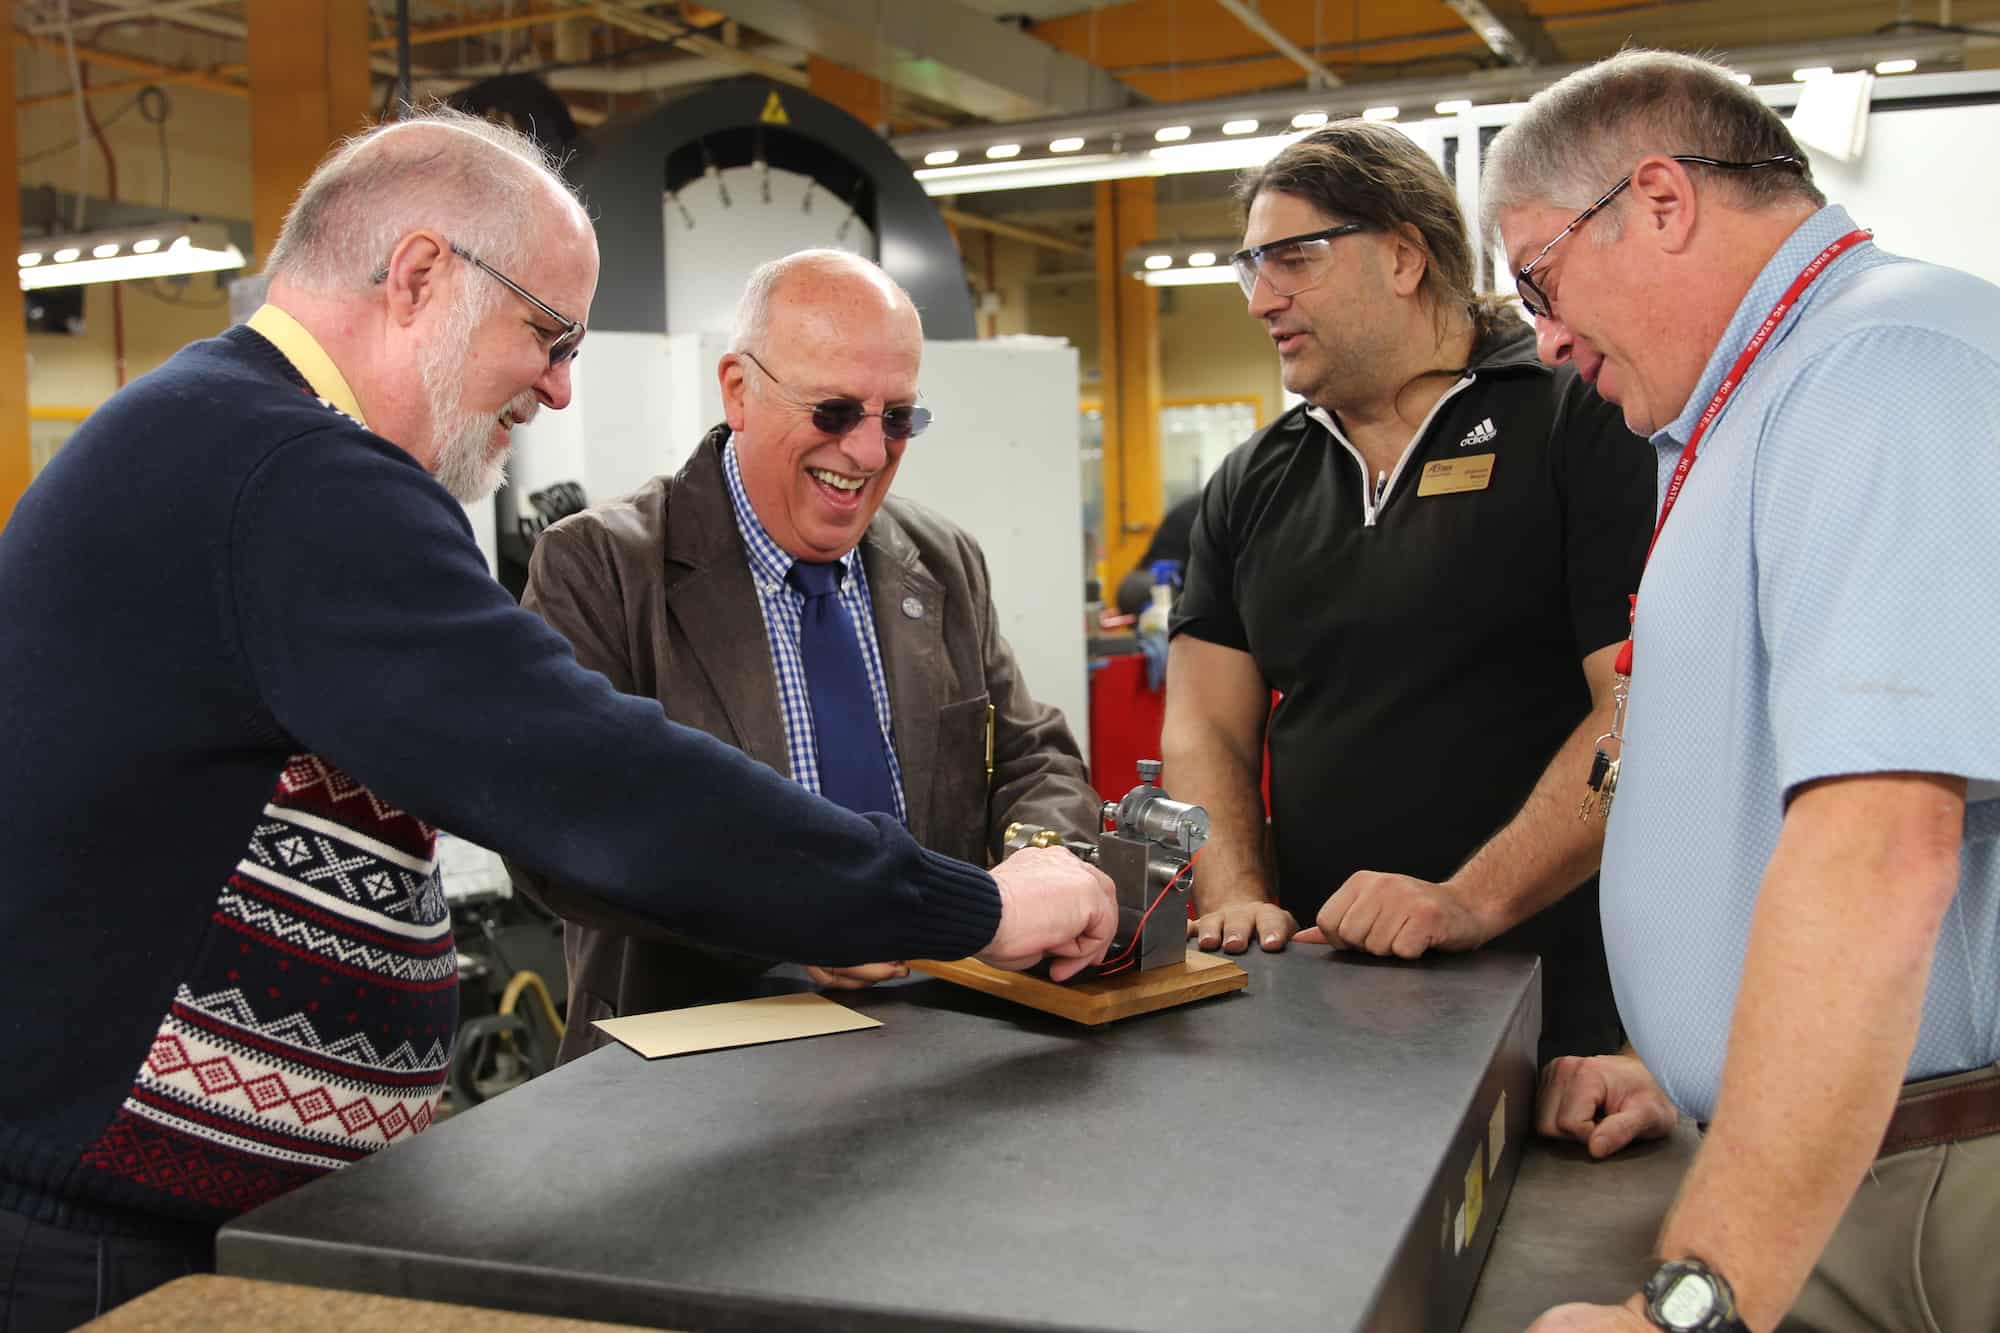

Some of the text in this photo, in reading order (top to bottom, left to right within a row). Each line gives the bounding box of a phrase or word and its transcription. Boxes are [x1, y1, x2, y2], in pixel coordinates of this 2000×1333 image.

[1751, 304, 1786, 348] NC STATE
[1703, 380, 1732, 424] NC STATE
[1460, 429, 1497, 447] adidas
[1666, 458, 1689, 503] NC STATE
